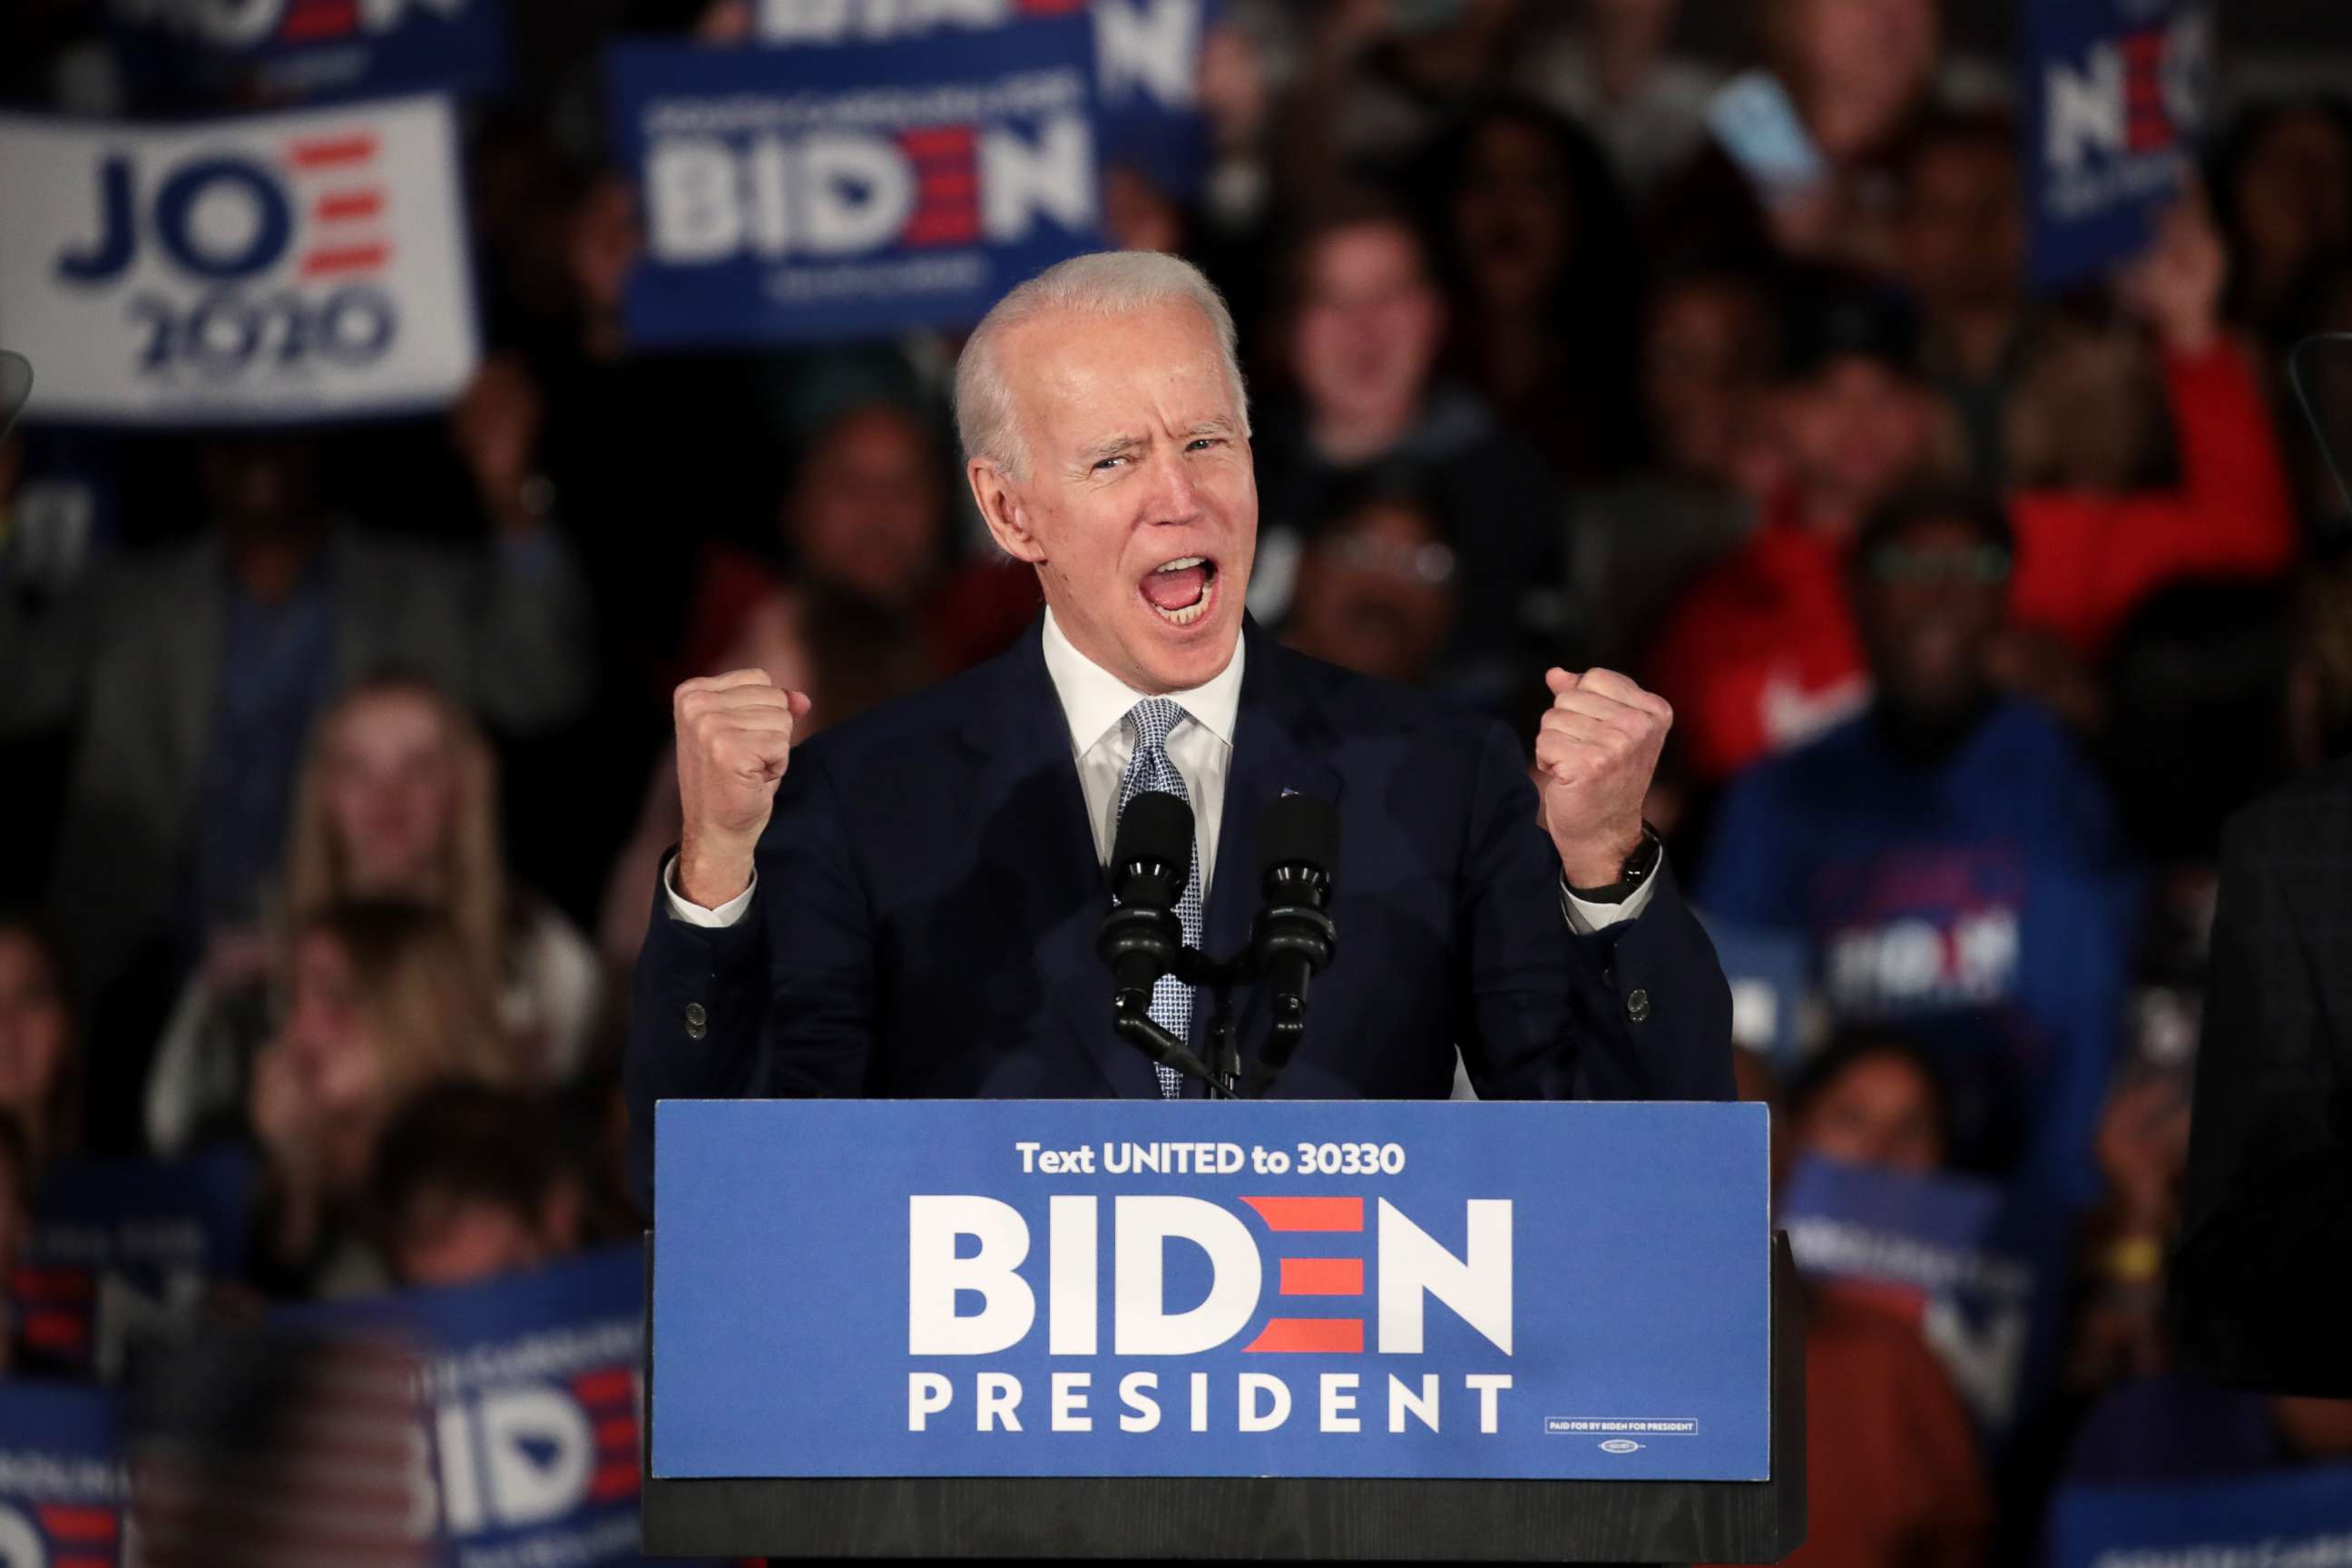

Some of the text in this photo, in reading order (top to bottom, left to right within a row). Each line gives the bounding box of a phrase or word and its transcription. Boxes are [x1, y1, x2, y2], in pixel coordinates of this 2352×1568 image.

[54, 134, 387, 289] JOE
[647, 116, 1094, 264] BIDEN
[132, 283, 399, 372] 2020
[1015, 1142, 1406, 1175] Text UNITED to 30330
[908, 1194, 1513, 1357] BIDEN
[908, 1371, 1513, 1434] PRESIDENT
[1549, 1421, 1694, 1432] PAID FOR BY BIDEN FOR PRESIDENT
